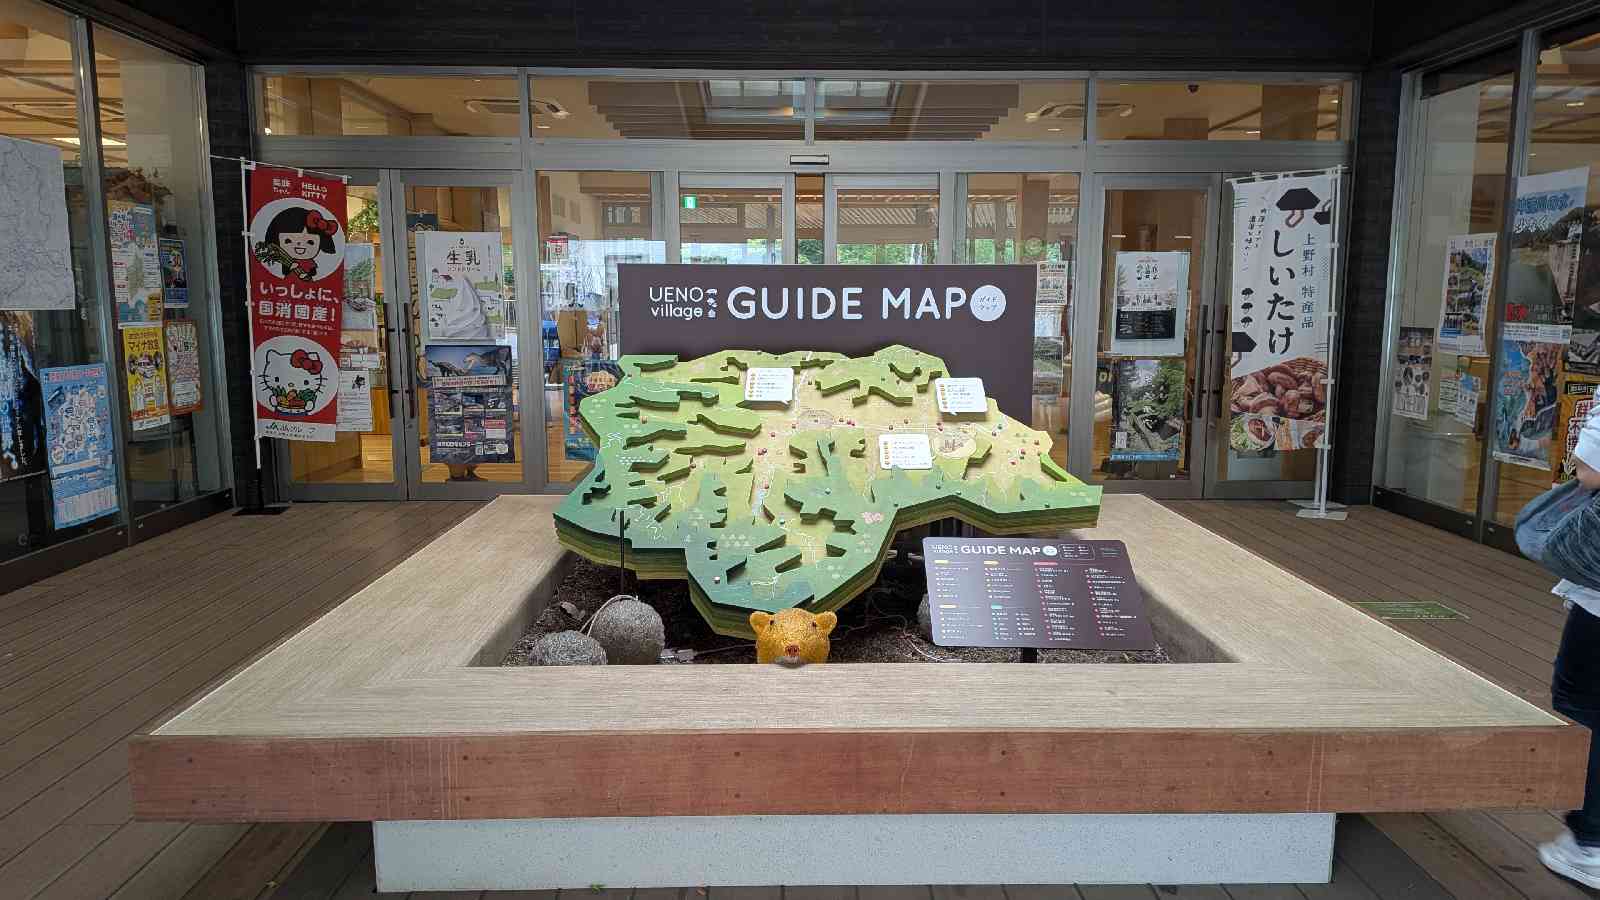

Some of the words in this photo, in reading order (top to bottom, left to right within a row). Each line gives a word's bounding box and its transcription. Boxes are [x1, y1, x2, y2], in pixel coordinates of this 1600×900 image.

[302, 181, 328, 193] HELLO
[302, 191, 327, 200] KITTY
[447, 249, 481, 266] 生乳
[1303, 232, 1316, 277] 上野村
[649, 287, 704, 302] UENO
[1267, 230, 1296, 355] しいたけ
[728, 286, 862, 319] GUIDE
[882, 287, 966, 319] MAP
[1301, 284, 1315, 329] 特産品
[651, 303, 704, 320] village
[960, 545, 1007, 555] GUIDE
[1009, 546, 1041, 556] MAP
